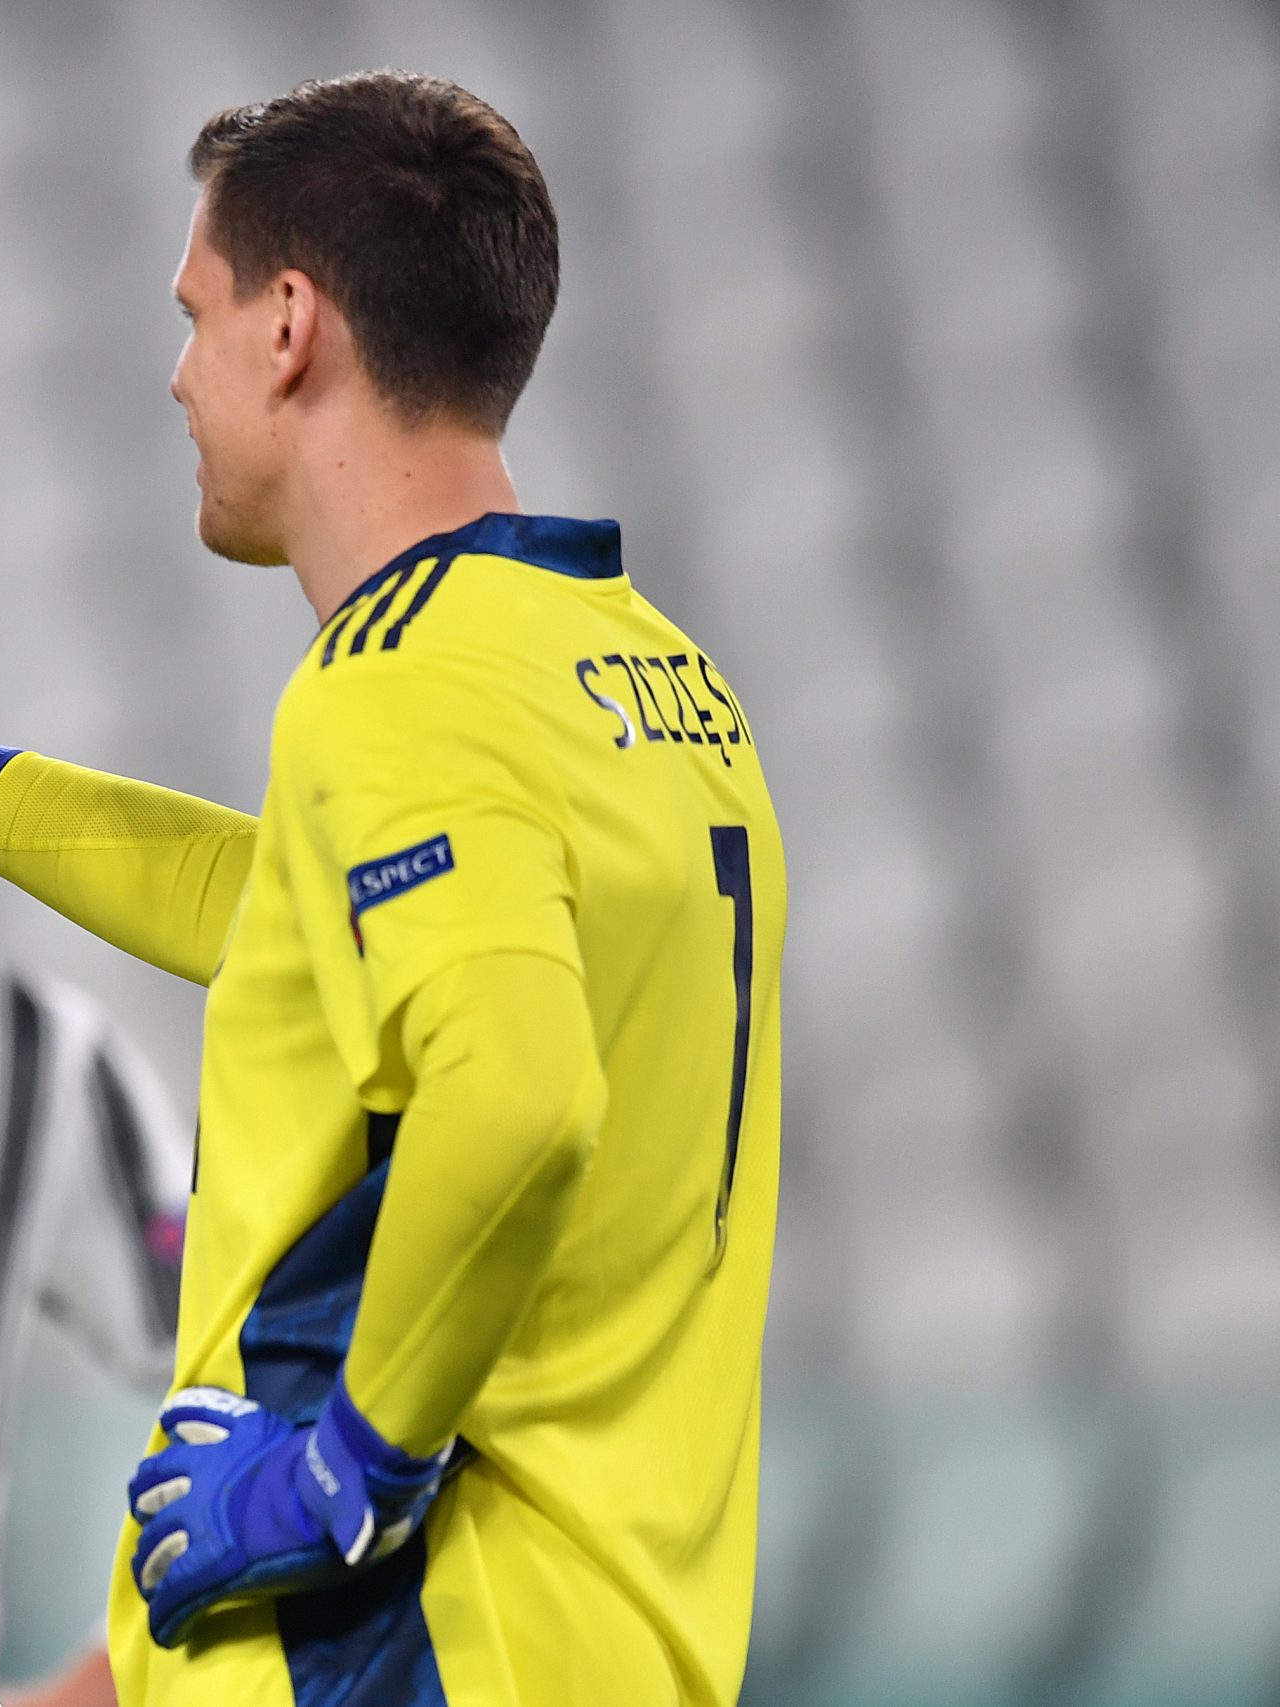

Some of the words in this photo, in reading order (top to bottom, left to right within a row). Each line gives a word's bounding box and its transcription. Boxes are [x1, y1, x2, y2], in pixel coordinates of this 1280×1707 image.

[576, 653, 751, 767] SZCZĘS
[350, 842, 448, 904] ESPECT
[709, 826, 753, 1272] 1
